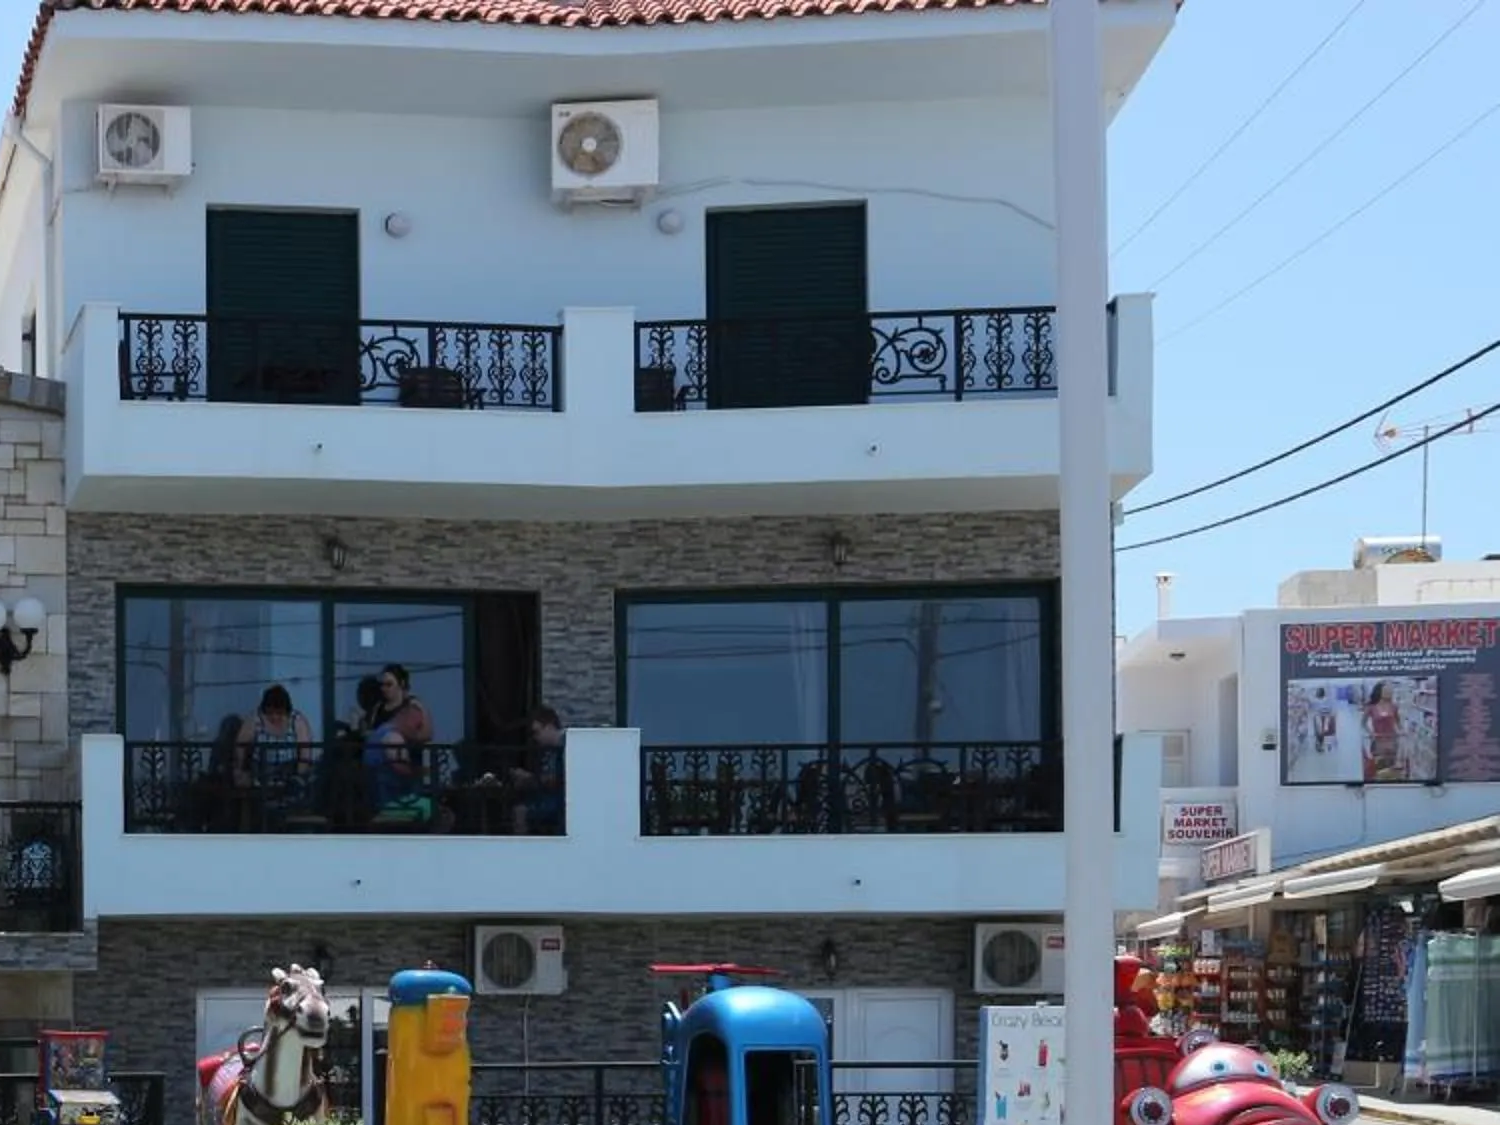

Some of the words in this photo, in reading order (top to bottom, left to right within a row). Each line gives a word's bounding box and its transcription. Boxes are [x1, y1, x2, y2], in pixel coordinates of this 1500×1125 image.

[1286, 624, 1376, 653] SUPER
[1383, 619, 1498, 649] MARKET
[1181, 805, 1223, 817] SUPER
[1173, 817, 1229, 828] MARKET
